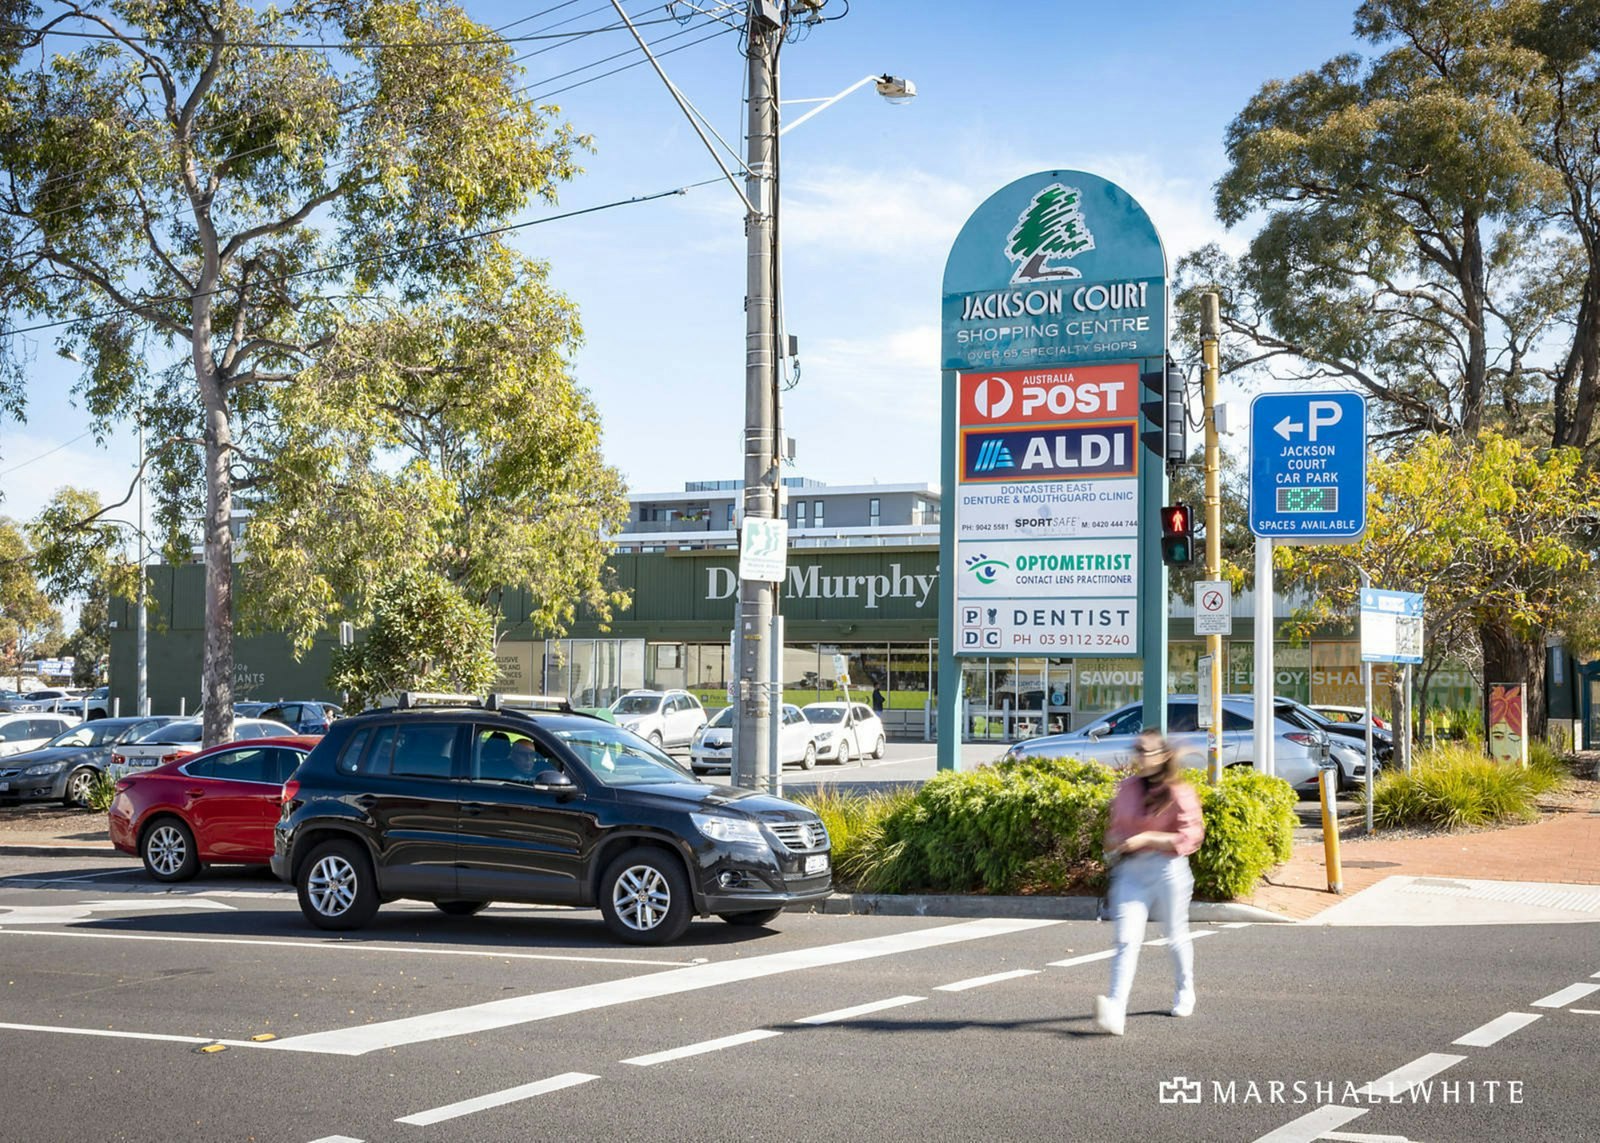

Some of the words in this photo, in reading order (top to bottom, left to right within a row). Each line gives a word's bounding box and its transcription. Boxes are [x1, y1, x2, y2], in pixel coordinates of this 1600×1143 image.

[961, 289, 1063, 321] JACKSON
[1073, 282, 1149, 312] COURT
[956, 324, 1060, 344] SHOPPING
[1065, 316, 1150, 336] CENTRE
[967, 349, 999, 360] OVER
[1003, 348, 1018, 358] 65
[1022, 344, 1089, 357] SPECIALTY
[1093, 340, 1137, 353] SHOPS
[1023, 373, 1074, 385] AUSTRALIA
[1022, 382, 1125, 416] POST
[1309, 400, 1343, 442] P
[1021, 432, 1125, 470] ALDI
[1280, 445, 1336, 457] JACKSON
[1287, 459, 1327, 470] COURT
[1275, 472, 1301, 483] CAR
[1306, 472, 1338, 483] PARK
[1001, 485, 1064, 495] DONCASTER
[1067, 483, 1094, 492] EAST
[963, 495, 1010, 505] DENTURE
[1013, 495, 1020, 504] &
[1023, 493, 1097, 504] MOUTHGUARD
[1100, 491, 1134, 501] CLINIC
[1287, 487, 1324, 511] 82
[975, 523, 992, 531] 9042
[1092, 521, 1109, 529] 0420
[1124, 520, 1138, 528] 744
[1259, 520, 1296, 530] SPACES
[1301, 519, 1355, 530] AVAILABLE
[1016, 554, 1132, 571] OPTOMETRIST
[1015, 575, 1053, 585] CONTACT
[1056, 575, 1074, 584] LENS
[1077, 574, 1132, 584] PRACTITIONER
[966, 610, 978, 623] P
[1013, 610, 1130, 626] DENTIST
[965, 632, 979, 645] D
[986, 632, 998, 645] C
[1013, 634, 1031, 645] PH
[1039, 634, 1056, 645] 03
[1060, 634, 1092, 645] 9112
[1096, 634, 1130, 645] 3240
